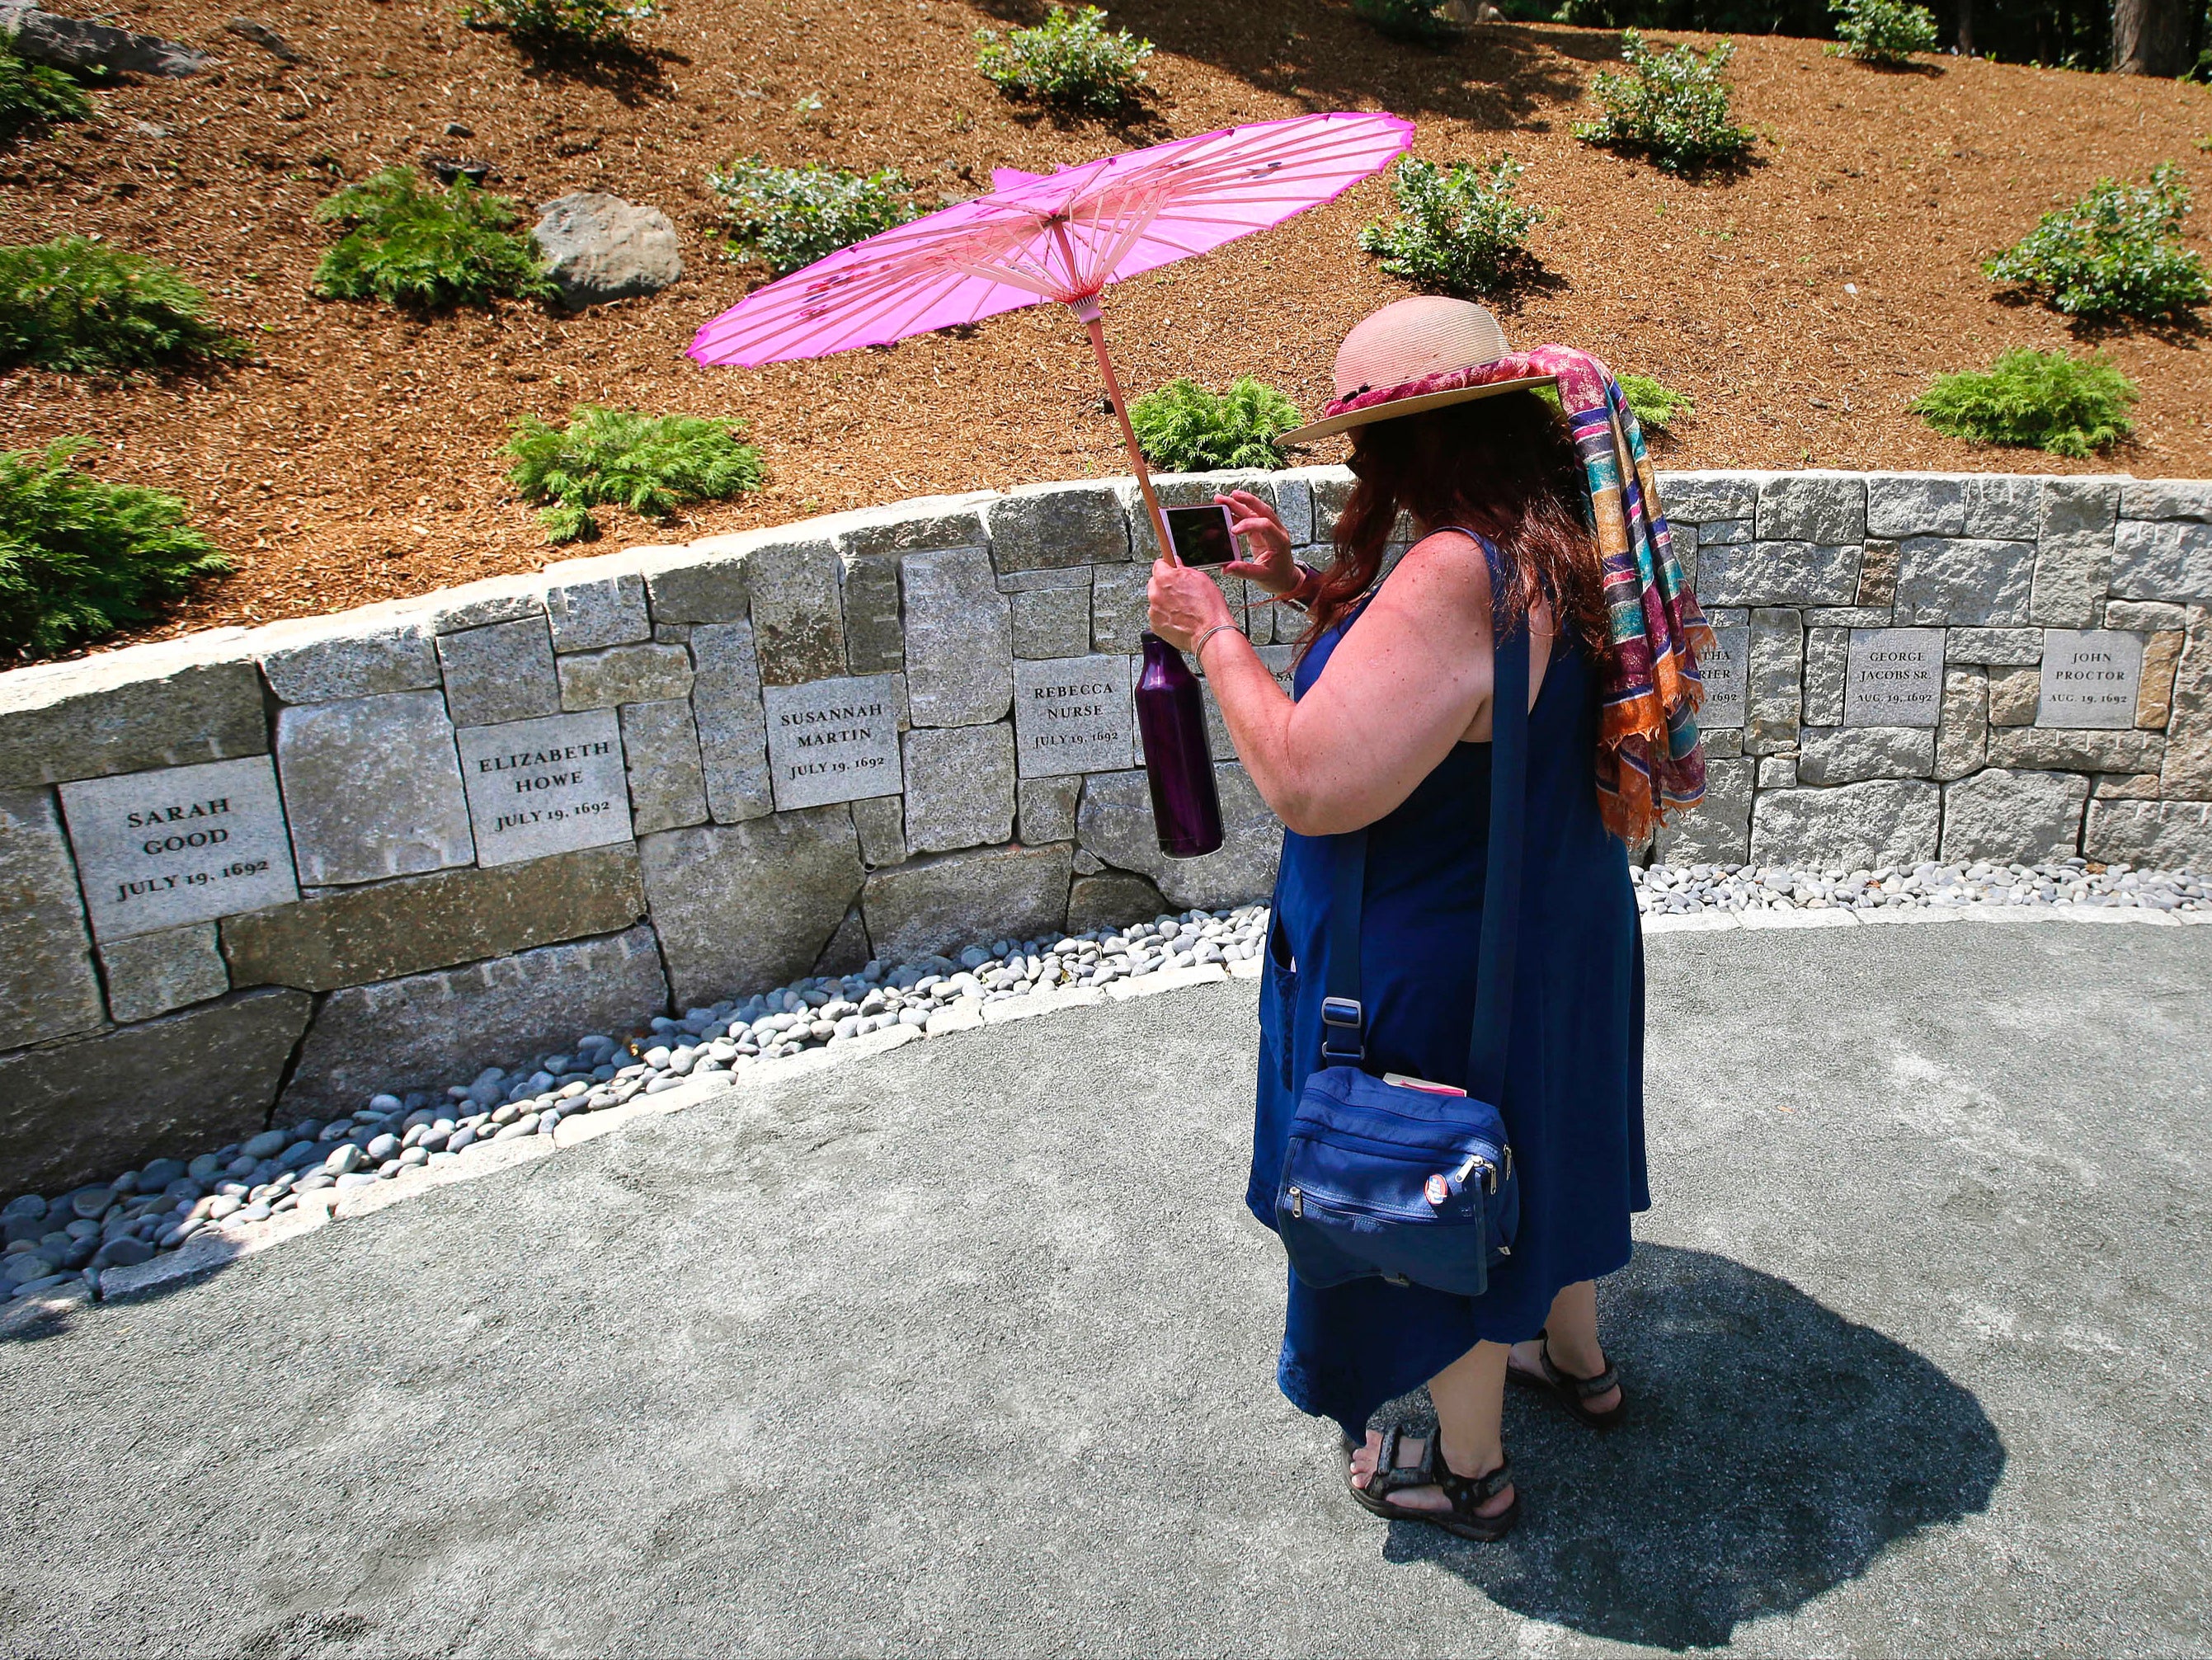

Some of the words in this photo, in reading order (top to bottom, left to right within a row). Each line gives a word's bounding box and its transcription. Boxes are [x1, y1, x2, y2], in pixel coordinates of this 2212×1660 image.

[1870, 651, 1925, 661] GEORGE
[2071, 652, 2111, 665] JOHN
[1859, 670, 1910, 683] JACOBS
[1913, 670, 1932, 680] SR.
[2056, 671, 2125, 680] PROCTOR
[1034, 683, 1113, 699] REBECCA
[1712, 692, 1737, 703] 1692
[1857, 694, 1884, 703] AUG.
[1907, 693, 1932, 704] 1692
[2101, 694, 2127, 704] 1692
[781, 703, 882, 727] SUSANNAH
[1047, 705, 1104, 719] NURSE
[798, 728, 871, 748] MARTIN
[1033, 735, 1067, 750] JULY
[1092, 732, 1118, 743] 1692
[478, 741, 609, 773] ELIZABETH
[789, 762, 827, 780] JULY
[855, 757, 884, 769] 1692
[515, 771, 583, 793] HOWE
[127, 797, 230, 828] SARAH
[495, 810, 542, 832] JULY
[575, 801, 609, 815] 1692
[144, 828, 228, 855] GOOD
[116, 874, 179, 902] JULY
[223, 860, 269, 878] 1692
